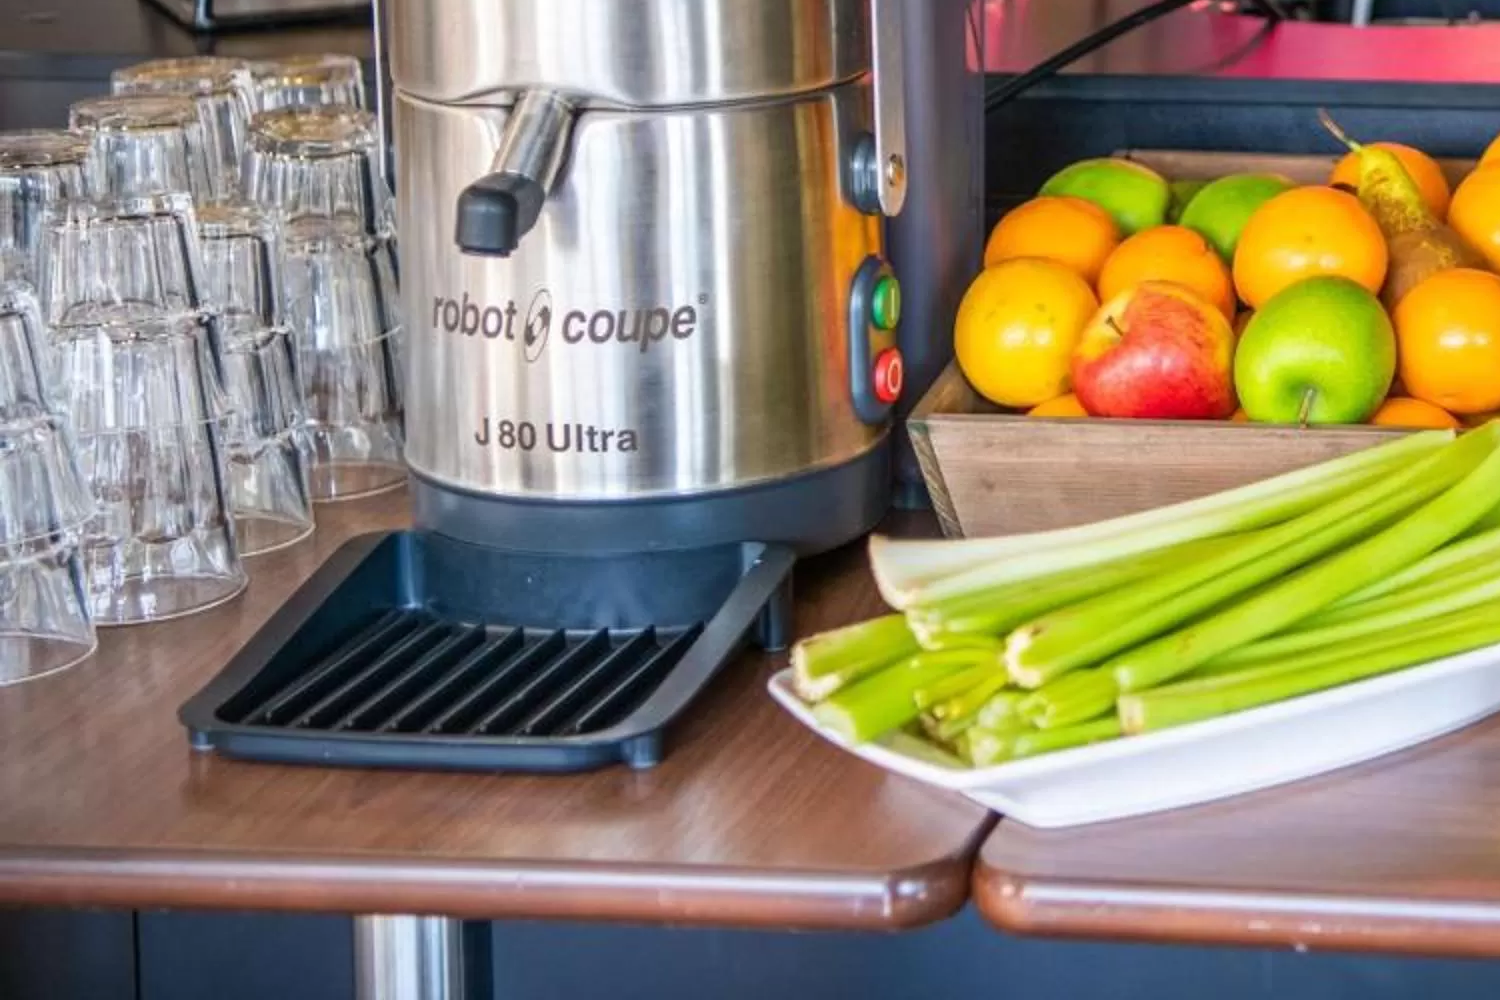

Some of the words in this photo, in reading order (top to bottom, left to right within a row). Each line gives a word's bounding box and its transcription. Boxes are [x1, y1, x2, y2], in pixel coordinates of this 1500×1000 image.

[432, 292, 517, 341] robot
[474, 417, 490, 446] J
[499, 421, 537, 451] 80
[546, 422, 638, 453] Ultra
